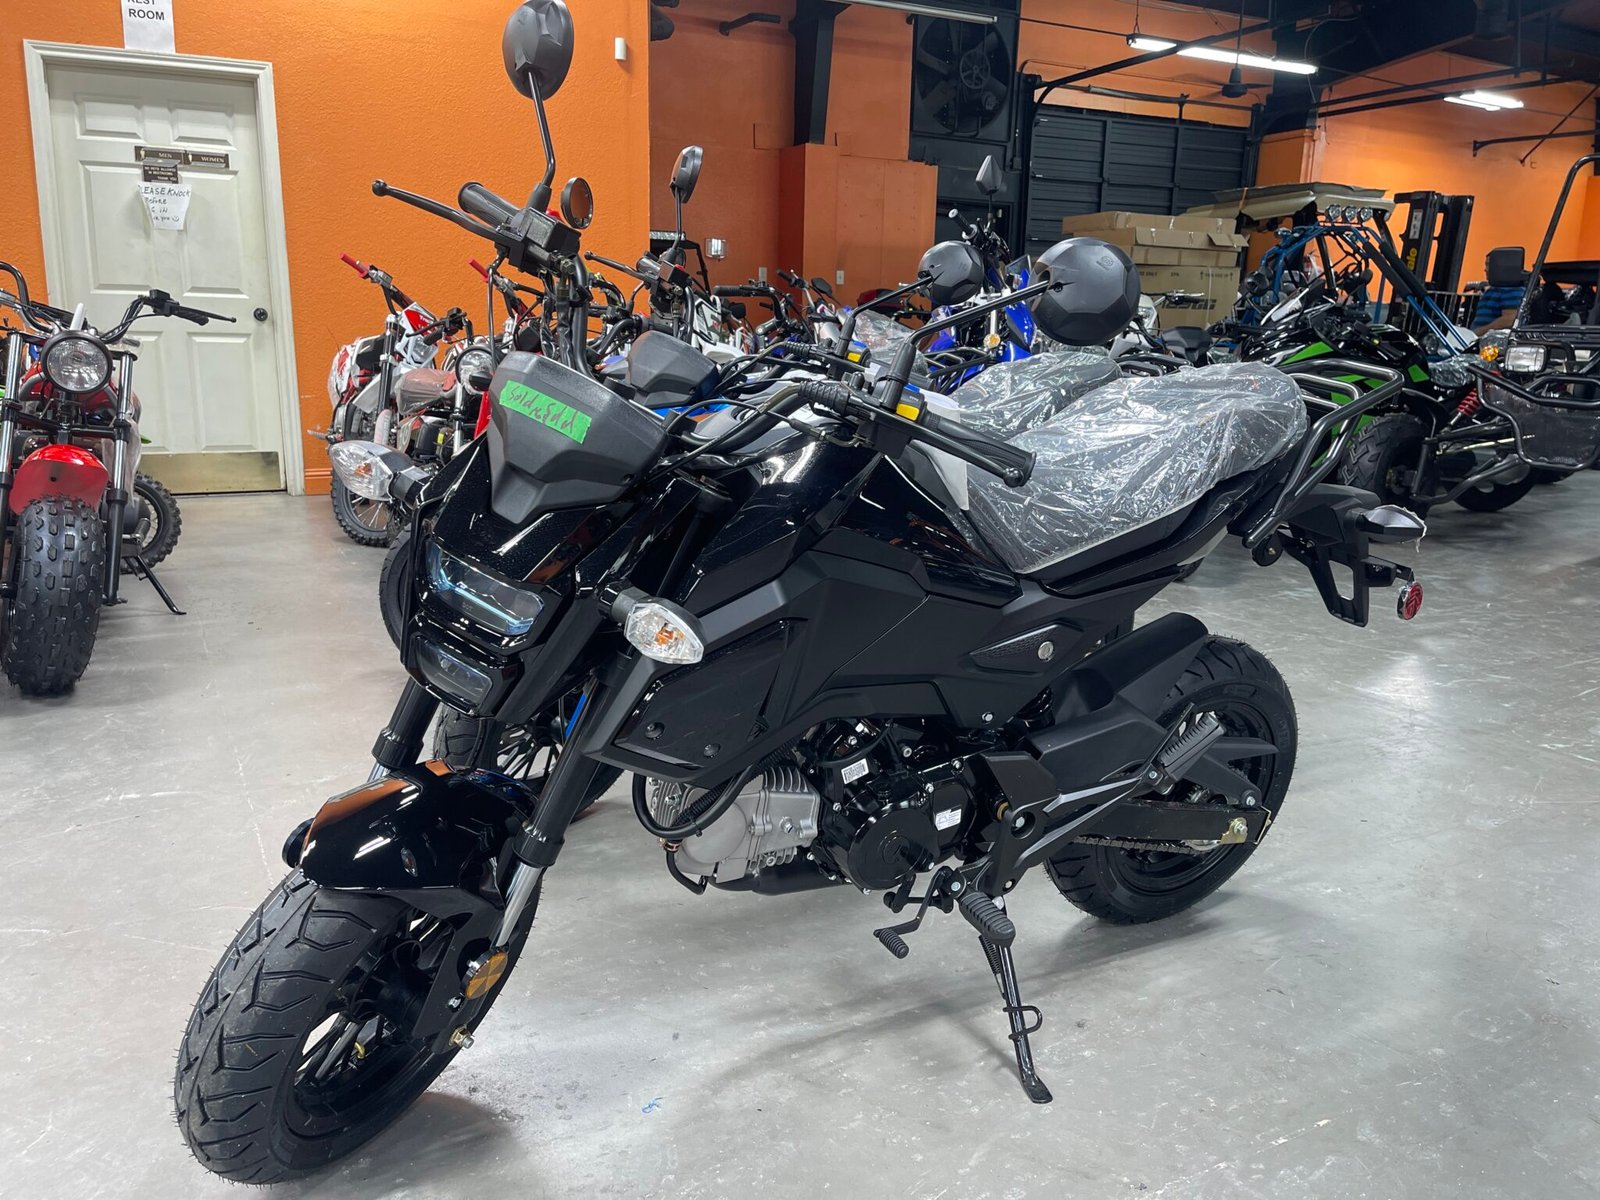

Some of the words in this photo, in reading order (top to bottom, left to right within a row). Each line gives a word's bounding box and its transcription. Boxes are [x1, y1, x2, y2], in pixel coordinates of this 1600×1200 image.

[128, 8, 165, 20] ROOM
[167, 187, 191, 197] KNOCK
[1406, 247, 1418, 271] ale
[509, 385, 540, 408] Sold
